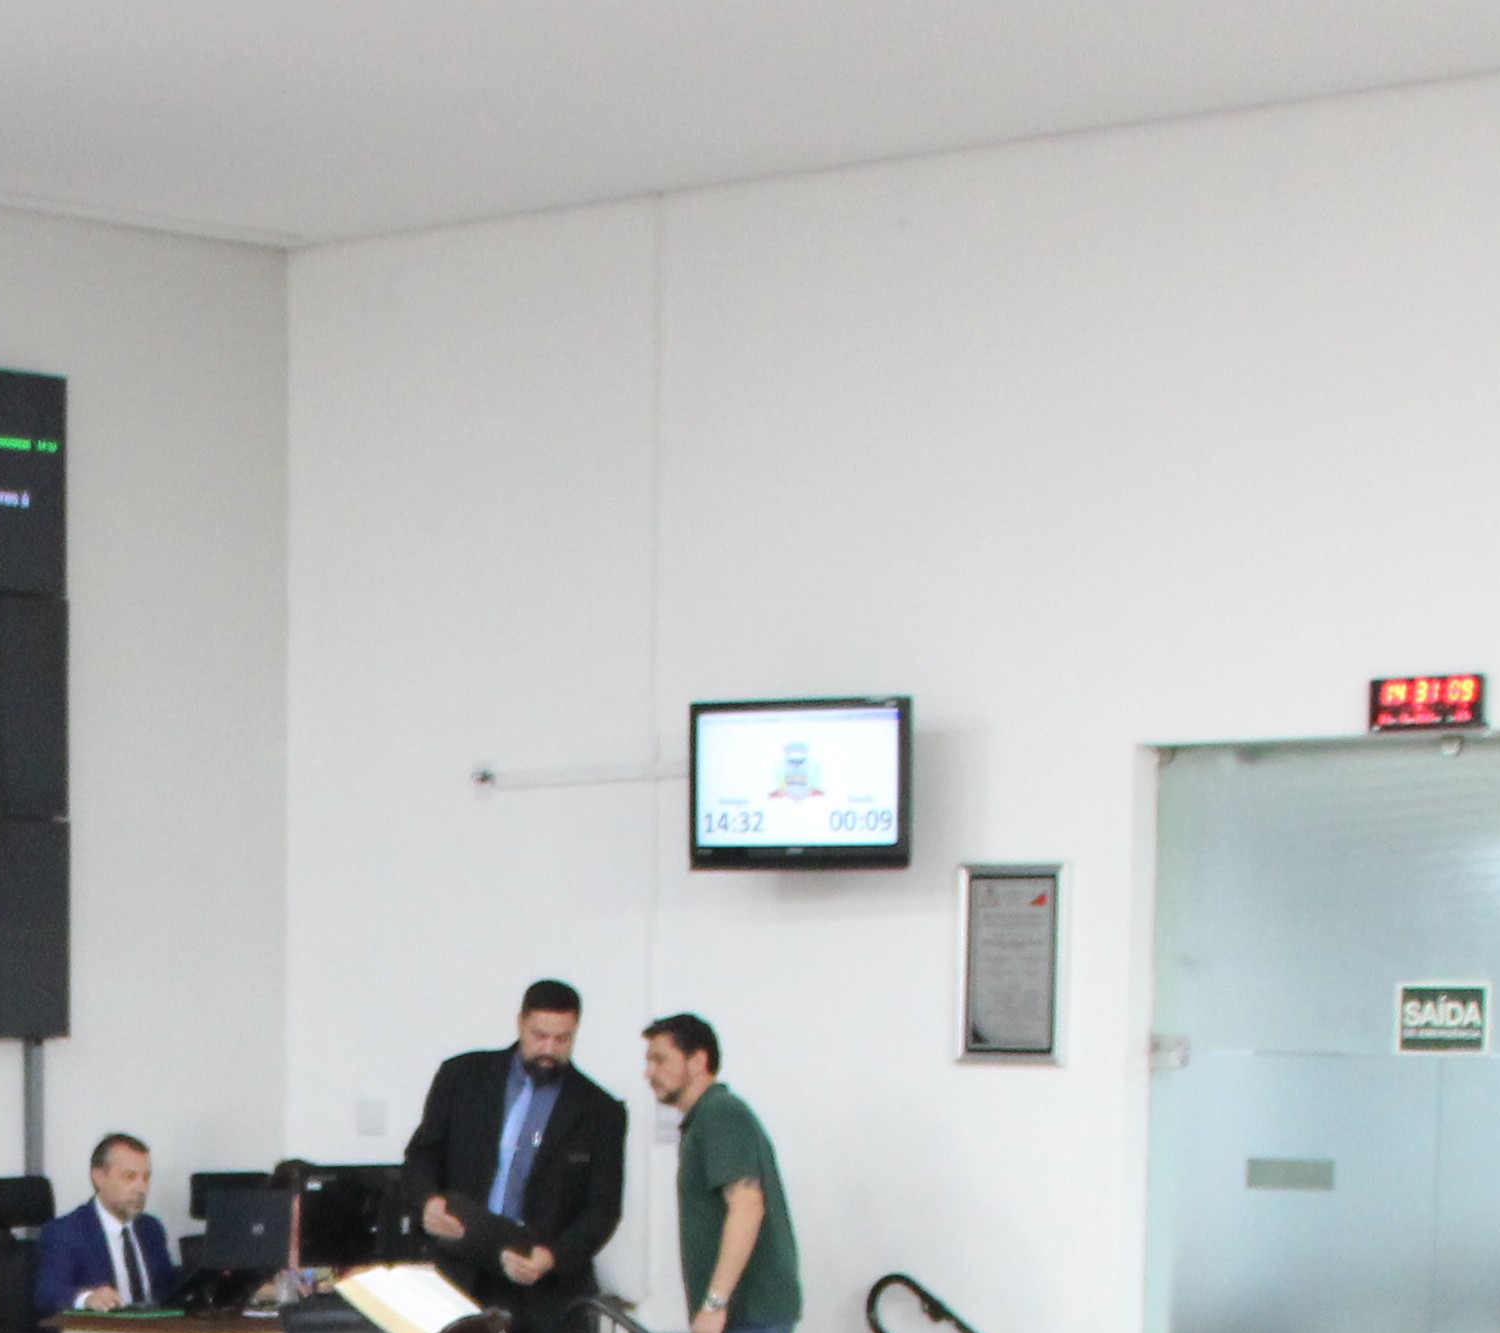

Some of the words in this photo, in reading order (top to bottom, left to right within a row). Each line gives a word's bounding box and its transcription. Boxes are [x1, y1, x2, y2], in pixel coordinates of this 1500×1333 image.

[704, 811, 764, 834] 14:32
[829, 810, 893, 832] 00:09
[1403, 994, 1482, 1028] SAÍDA
